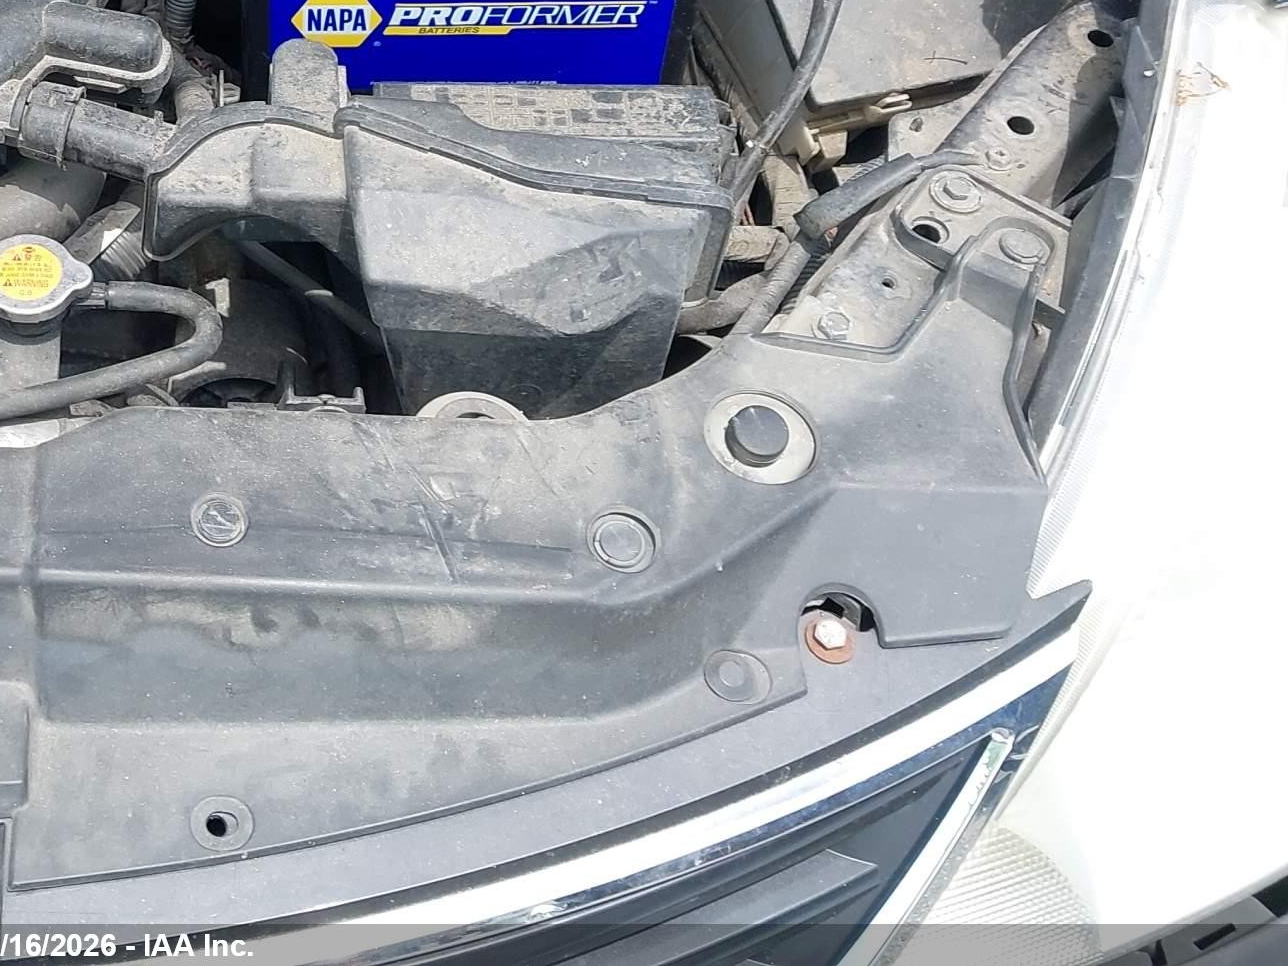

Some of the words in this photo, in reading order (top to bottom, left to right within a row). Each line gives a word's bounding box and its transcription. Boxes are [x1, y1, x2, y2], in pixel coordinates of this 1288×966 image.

[306, 7, 368, 33] NAPA
[388, 3, 646, 27] PROFORMER
[418, 26, 480, 36] BATTERIES
